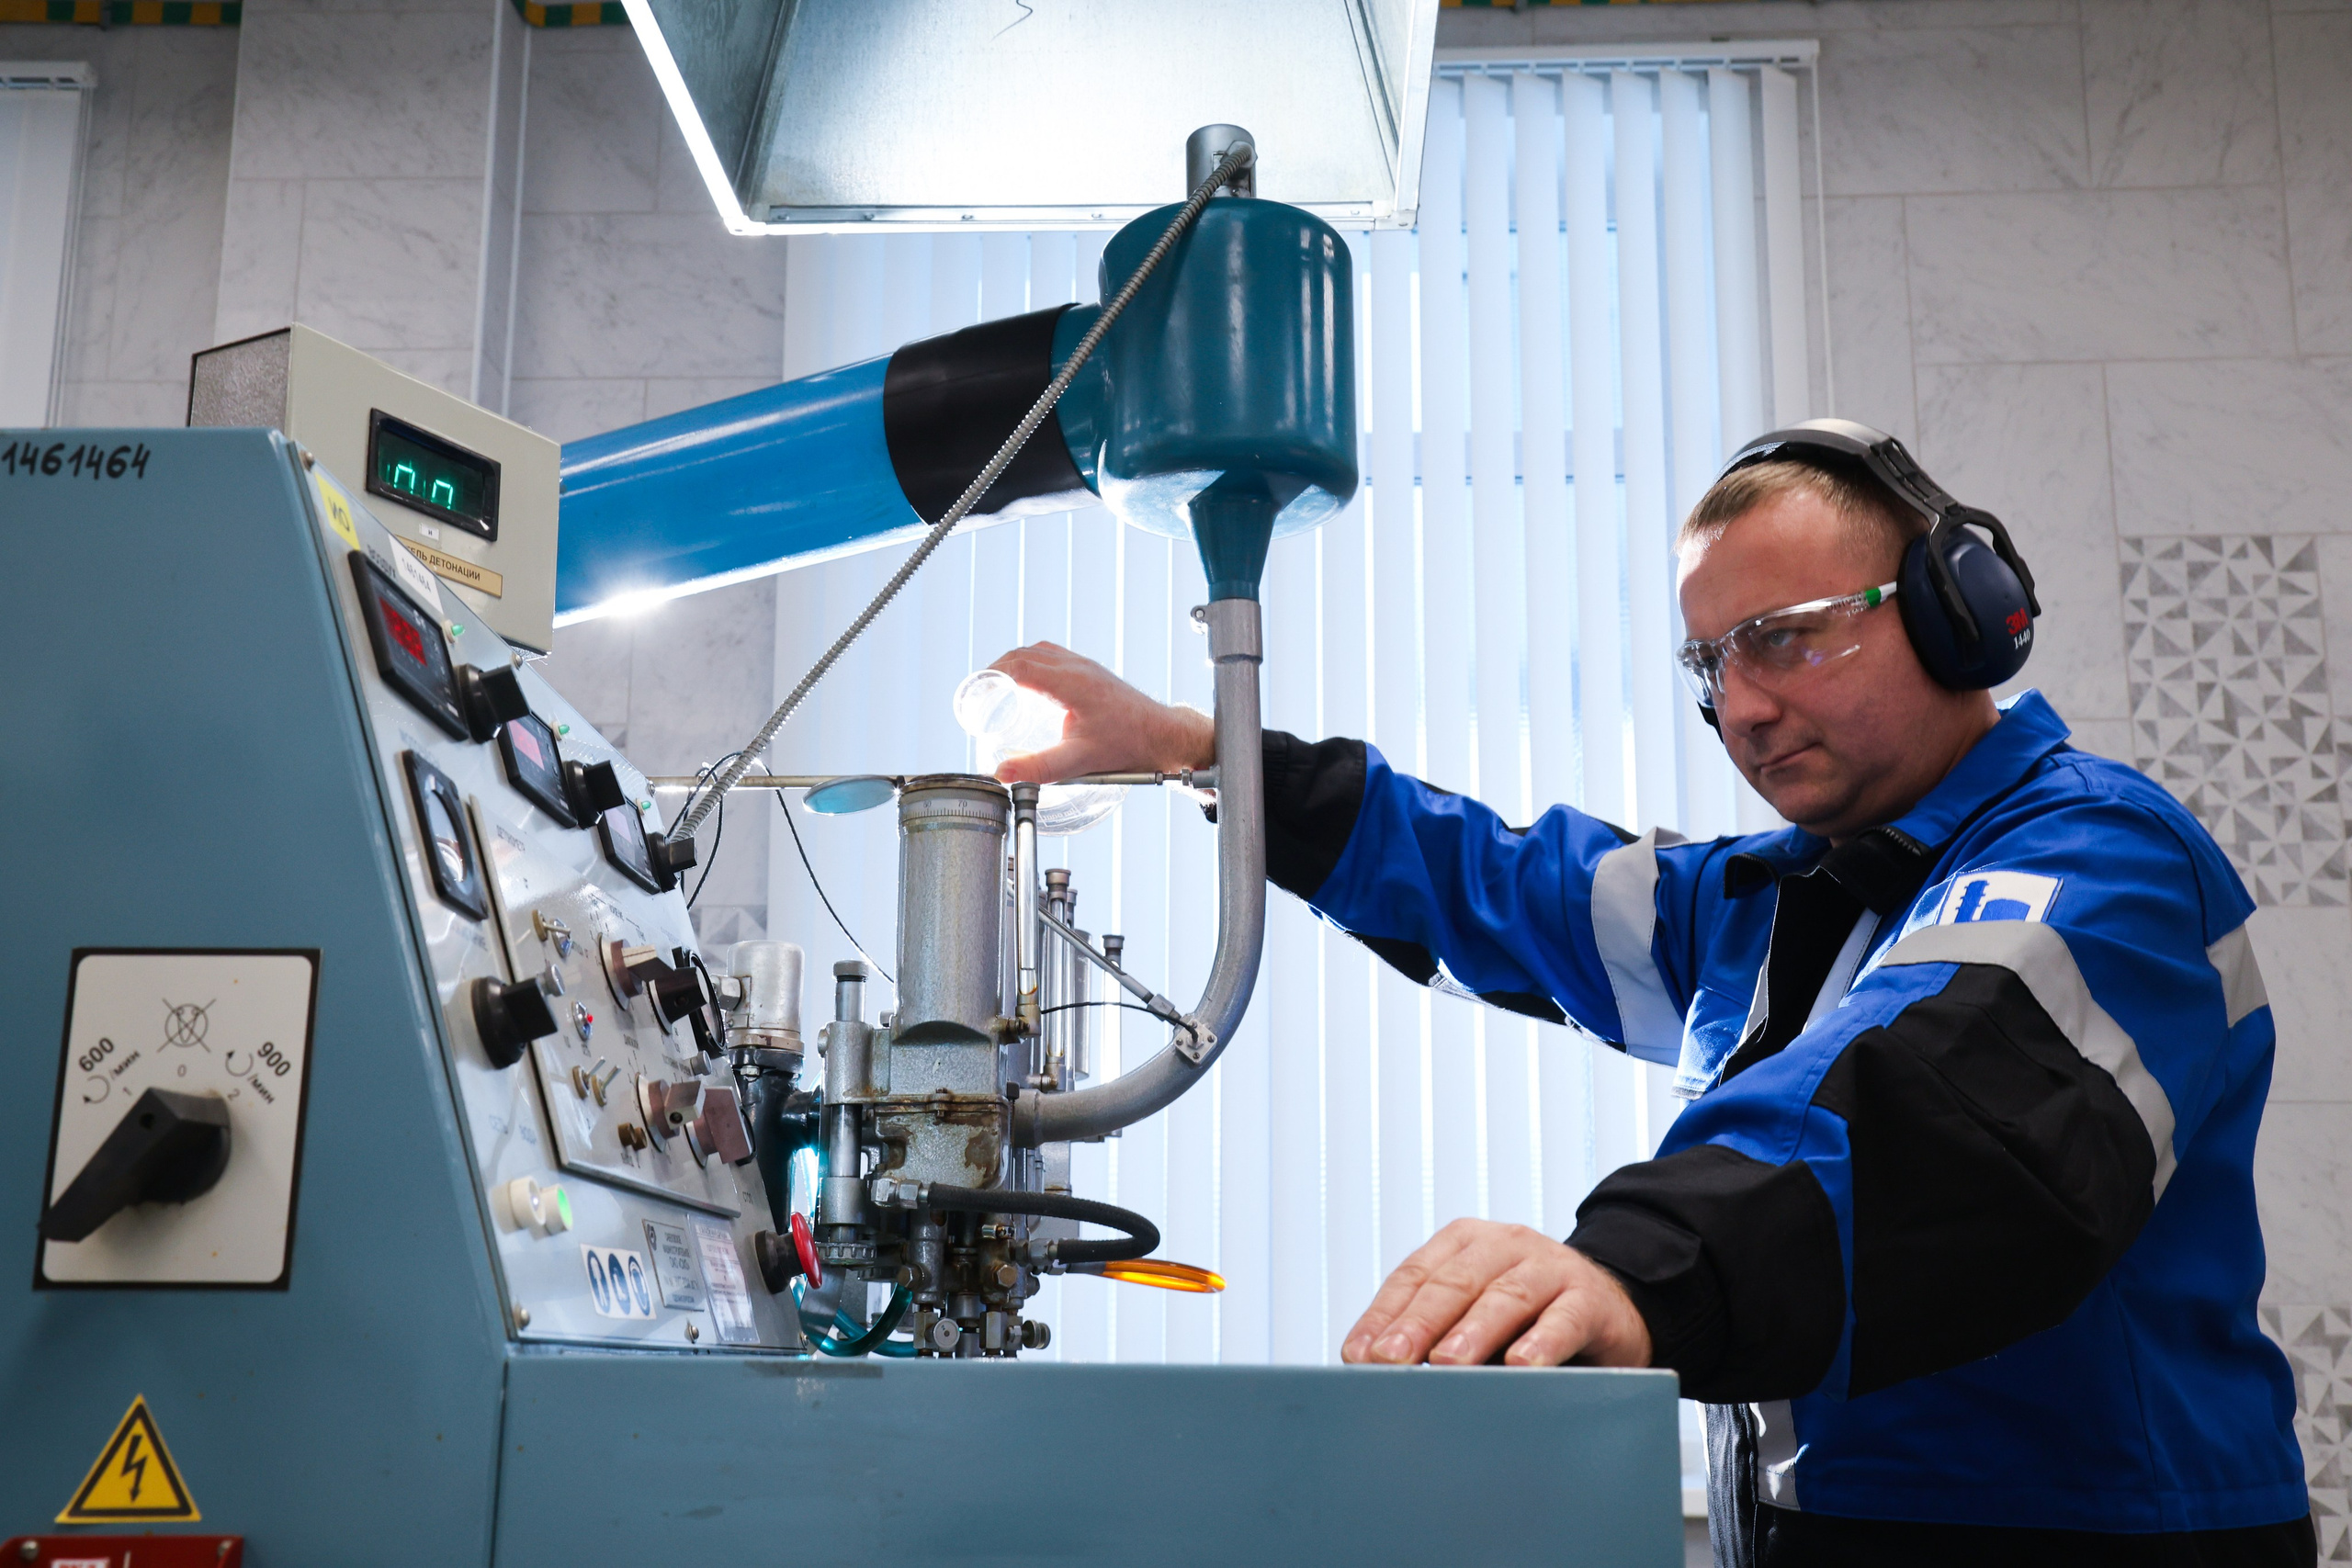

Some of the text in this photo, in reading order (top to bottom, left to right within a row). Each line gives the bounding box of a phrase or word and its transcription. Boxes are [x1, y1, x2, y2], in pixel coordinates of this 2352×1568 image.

[1, 441, 151, 480] 1461464
[429, 554, 481, 581] ДЕТОНАЦИИ
[2006, 607, 2029, 635] 3M
[2014, 628, 2030, 649] 1440
[957, 799, 967, 807] 70
[79, 1037, 115, 1072] 600
[257, 1041, 291, 1077] 900
[177, 1064, 187, 1077] 0
[228, 1088, 240, 1100] 2
